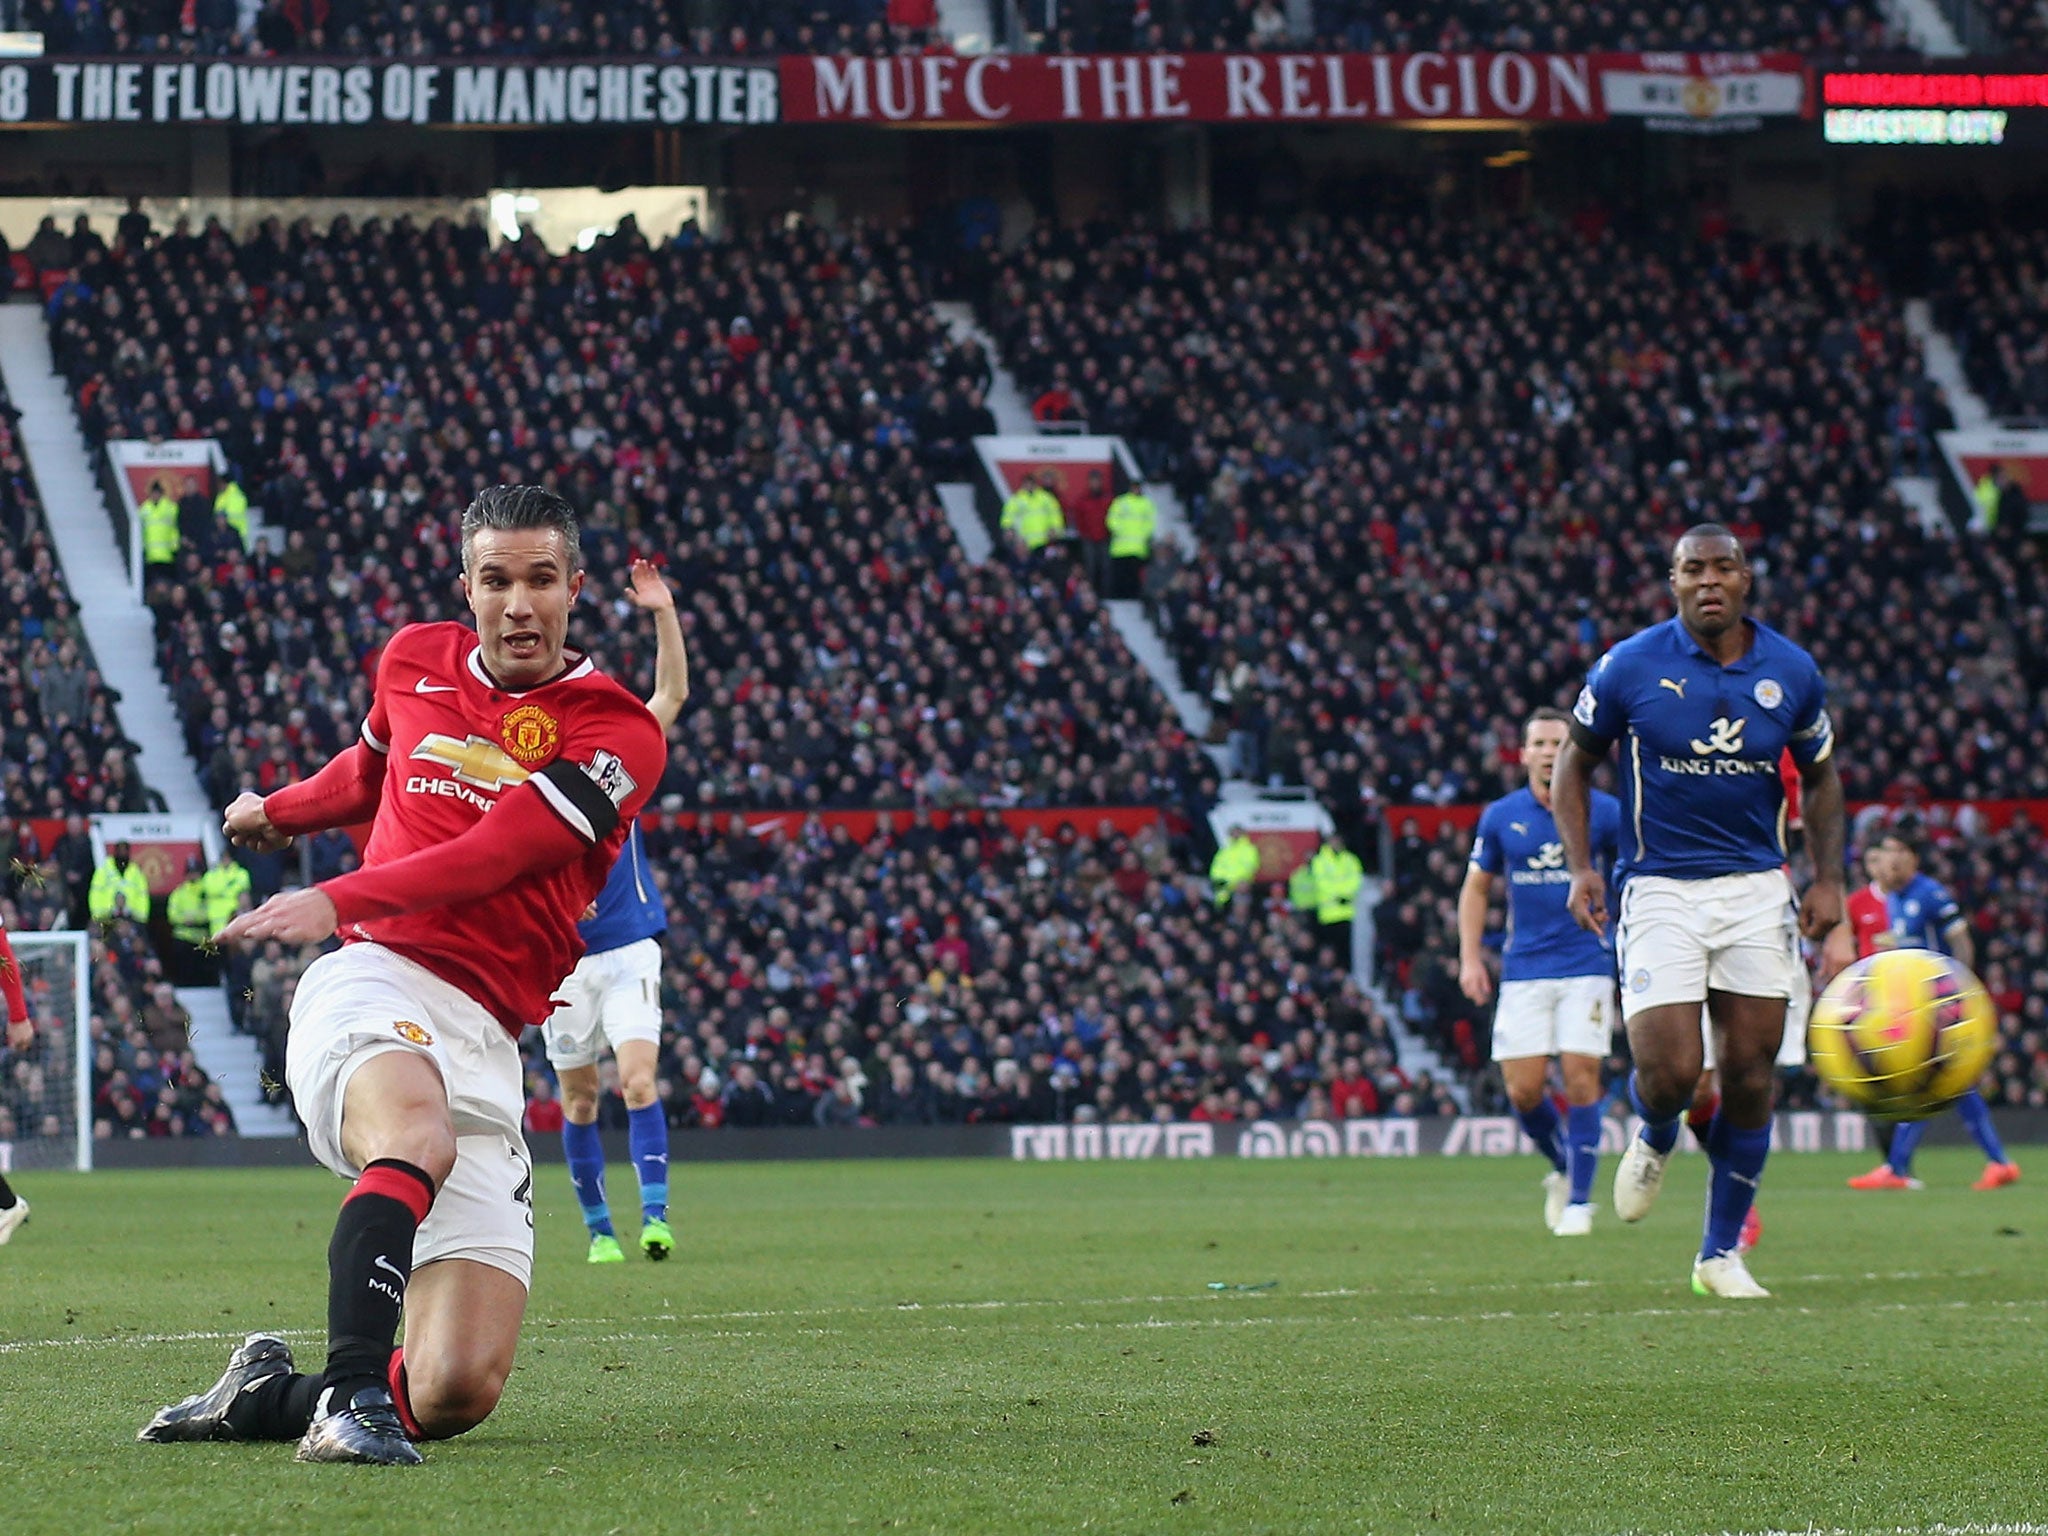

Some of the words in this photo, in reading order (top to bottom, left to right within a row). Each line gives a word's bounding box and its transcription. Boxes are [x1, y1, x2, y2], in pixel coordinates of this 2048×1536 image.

[53, 64, 141, 121] THE
[153, 63, 372, 123] FLOWERS
[382, 63, 439, 123] OF
[453, 64, 777, 124] MANCHESTER
[812, 54, 1010, 119] MUFC
[1047, 56, 1190, 118] THE
[1225, 52, 1592, 117] RELIGION
[512, 745, 545, 760] UNITED
[1659, 755, 1711, 776] KING
